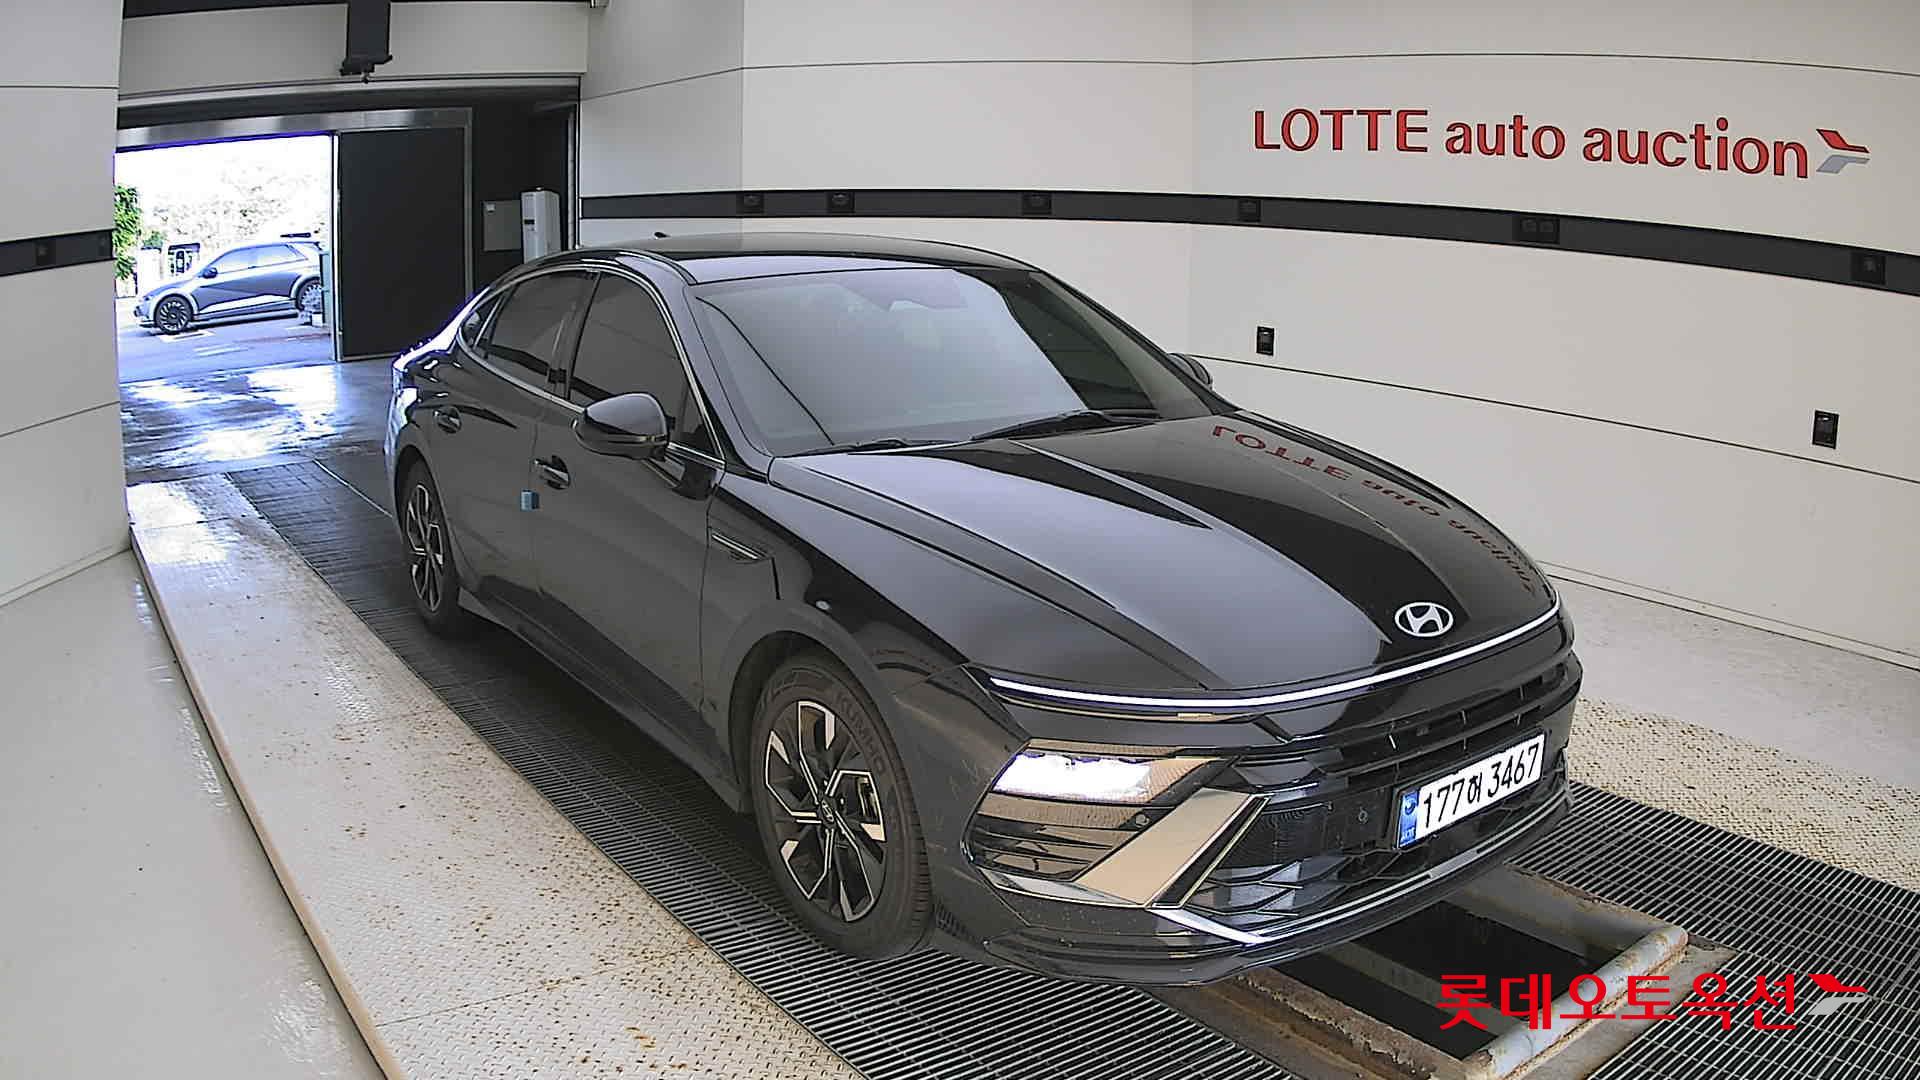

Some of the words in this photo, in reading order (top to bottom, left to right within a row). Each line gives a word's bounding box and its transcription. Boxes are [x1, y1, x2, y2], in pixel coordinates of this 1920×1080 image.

[1254, 108, 1429, 153] LOTTE
[1445, 115, 1566, 160] auto
[1583, 117, 1809, 179] auction
[1487, 742, 1540, 798] 3467
